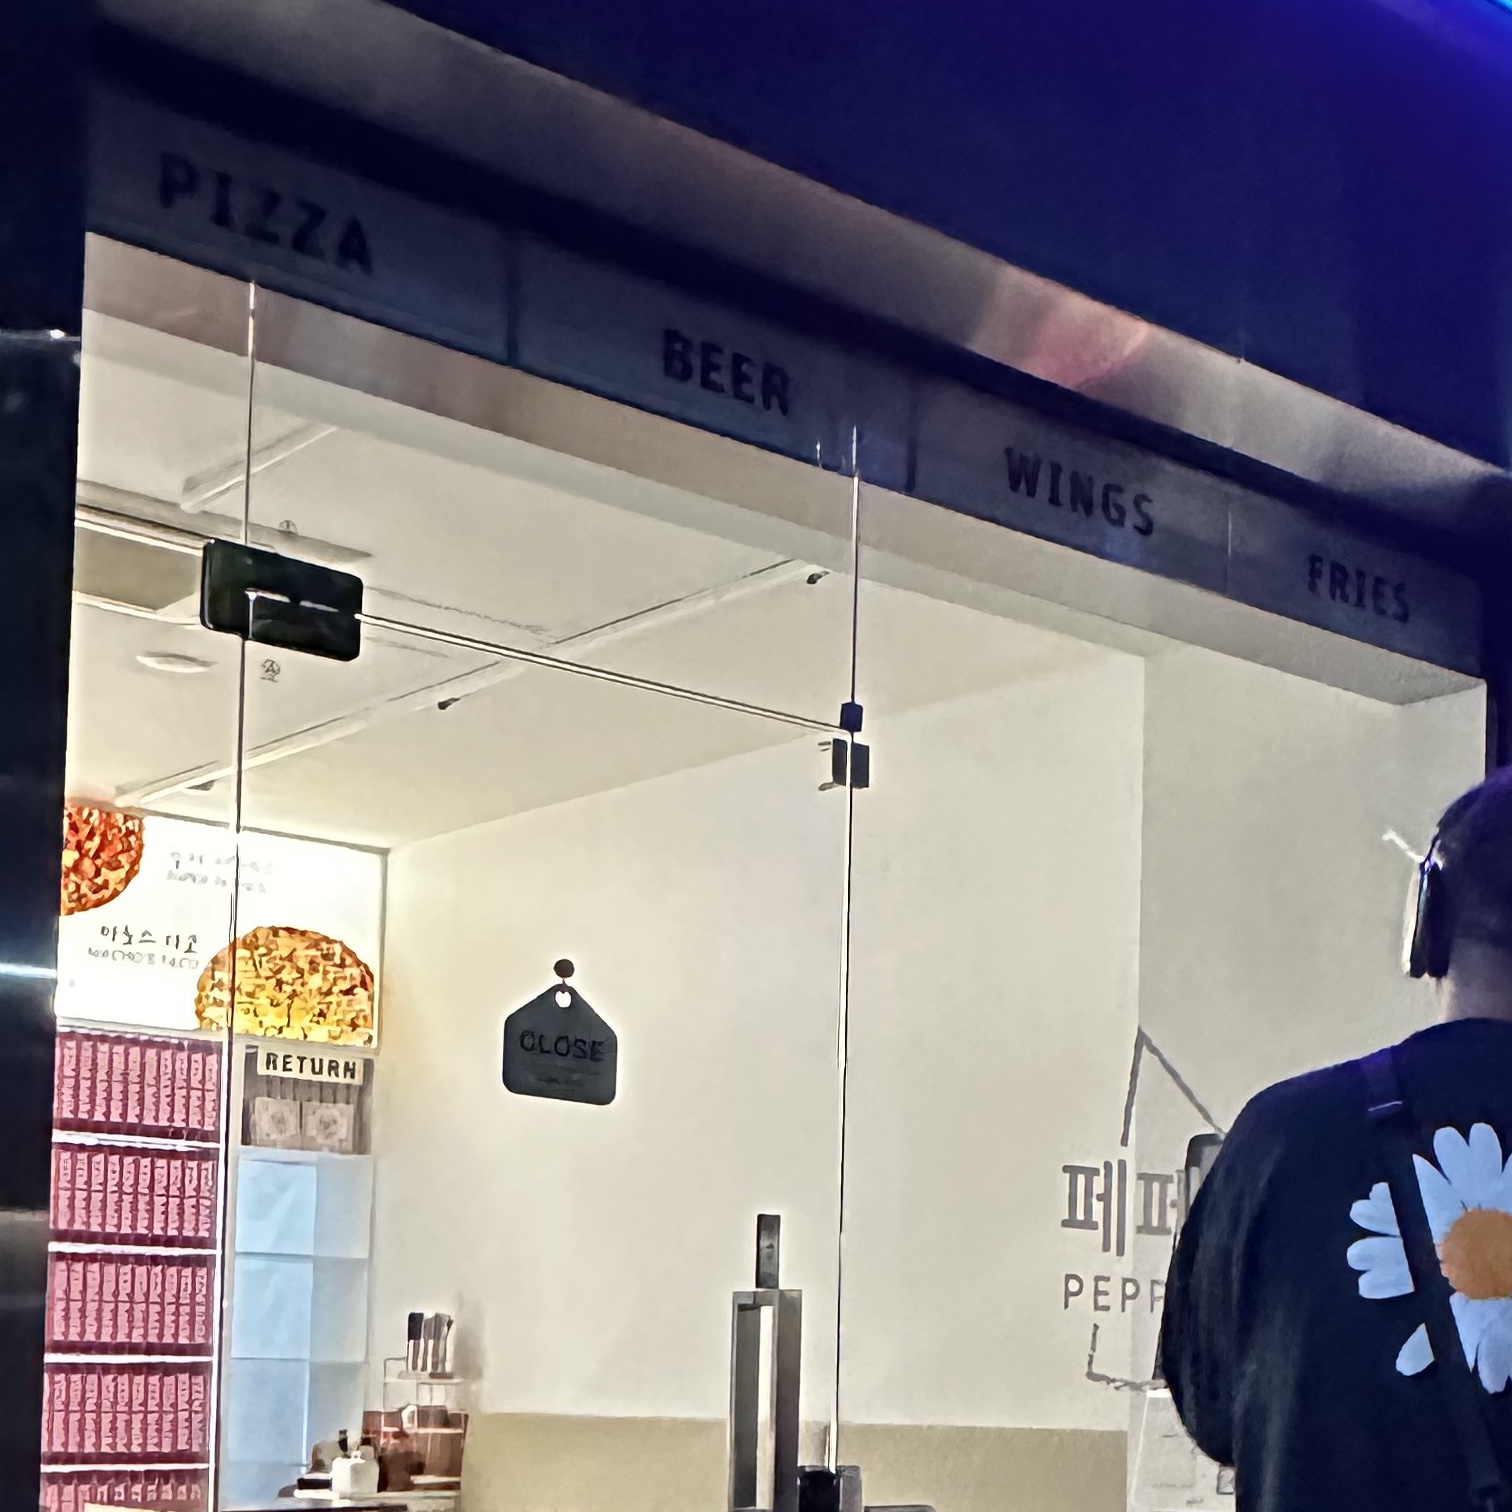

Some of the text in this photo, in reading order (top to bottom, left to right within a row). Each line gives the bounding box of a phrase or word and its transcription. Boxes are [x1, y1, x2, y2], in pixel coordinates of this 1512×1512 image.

[160, 152, 373, 276] PIZZA
[661, 328, 790, 416] BEER
[1005, 447, 1154, 536] WINGS
[1307, 555, 1410, 623] FRIES
[265, 1052, 356, 1080] RETURN
[519, 1030, 606, 1063] CLOSE
